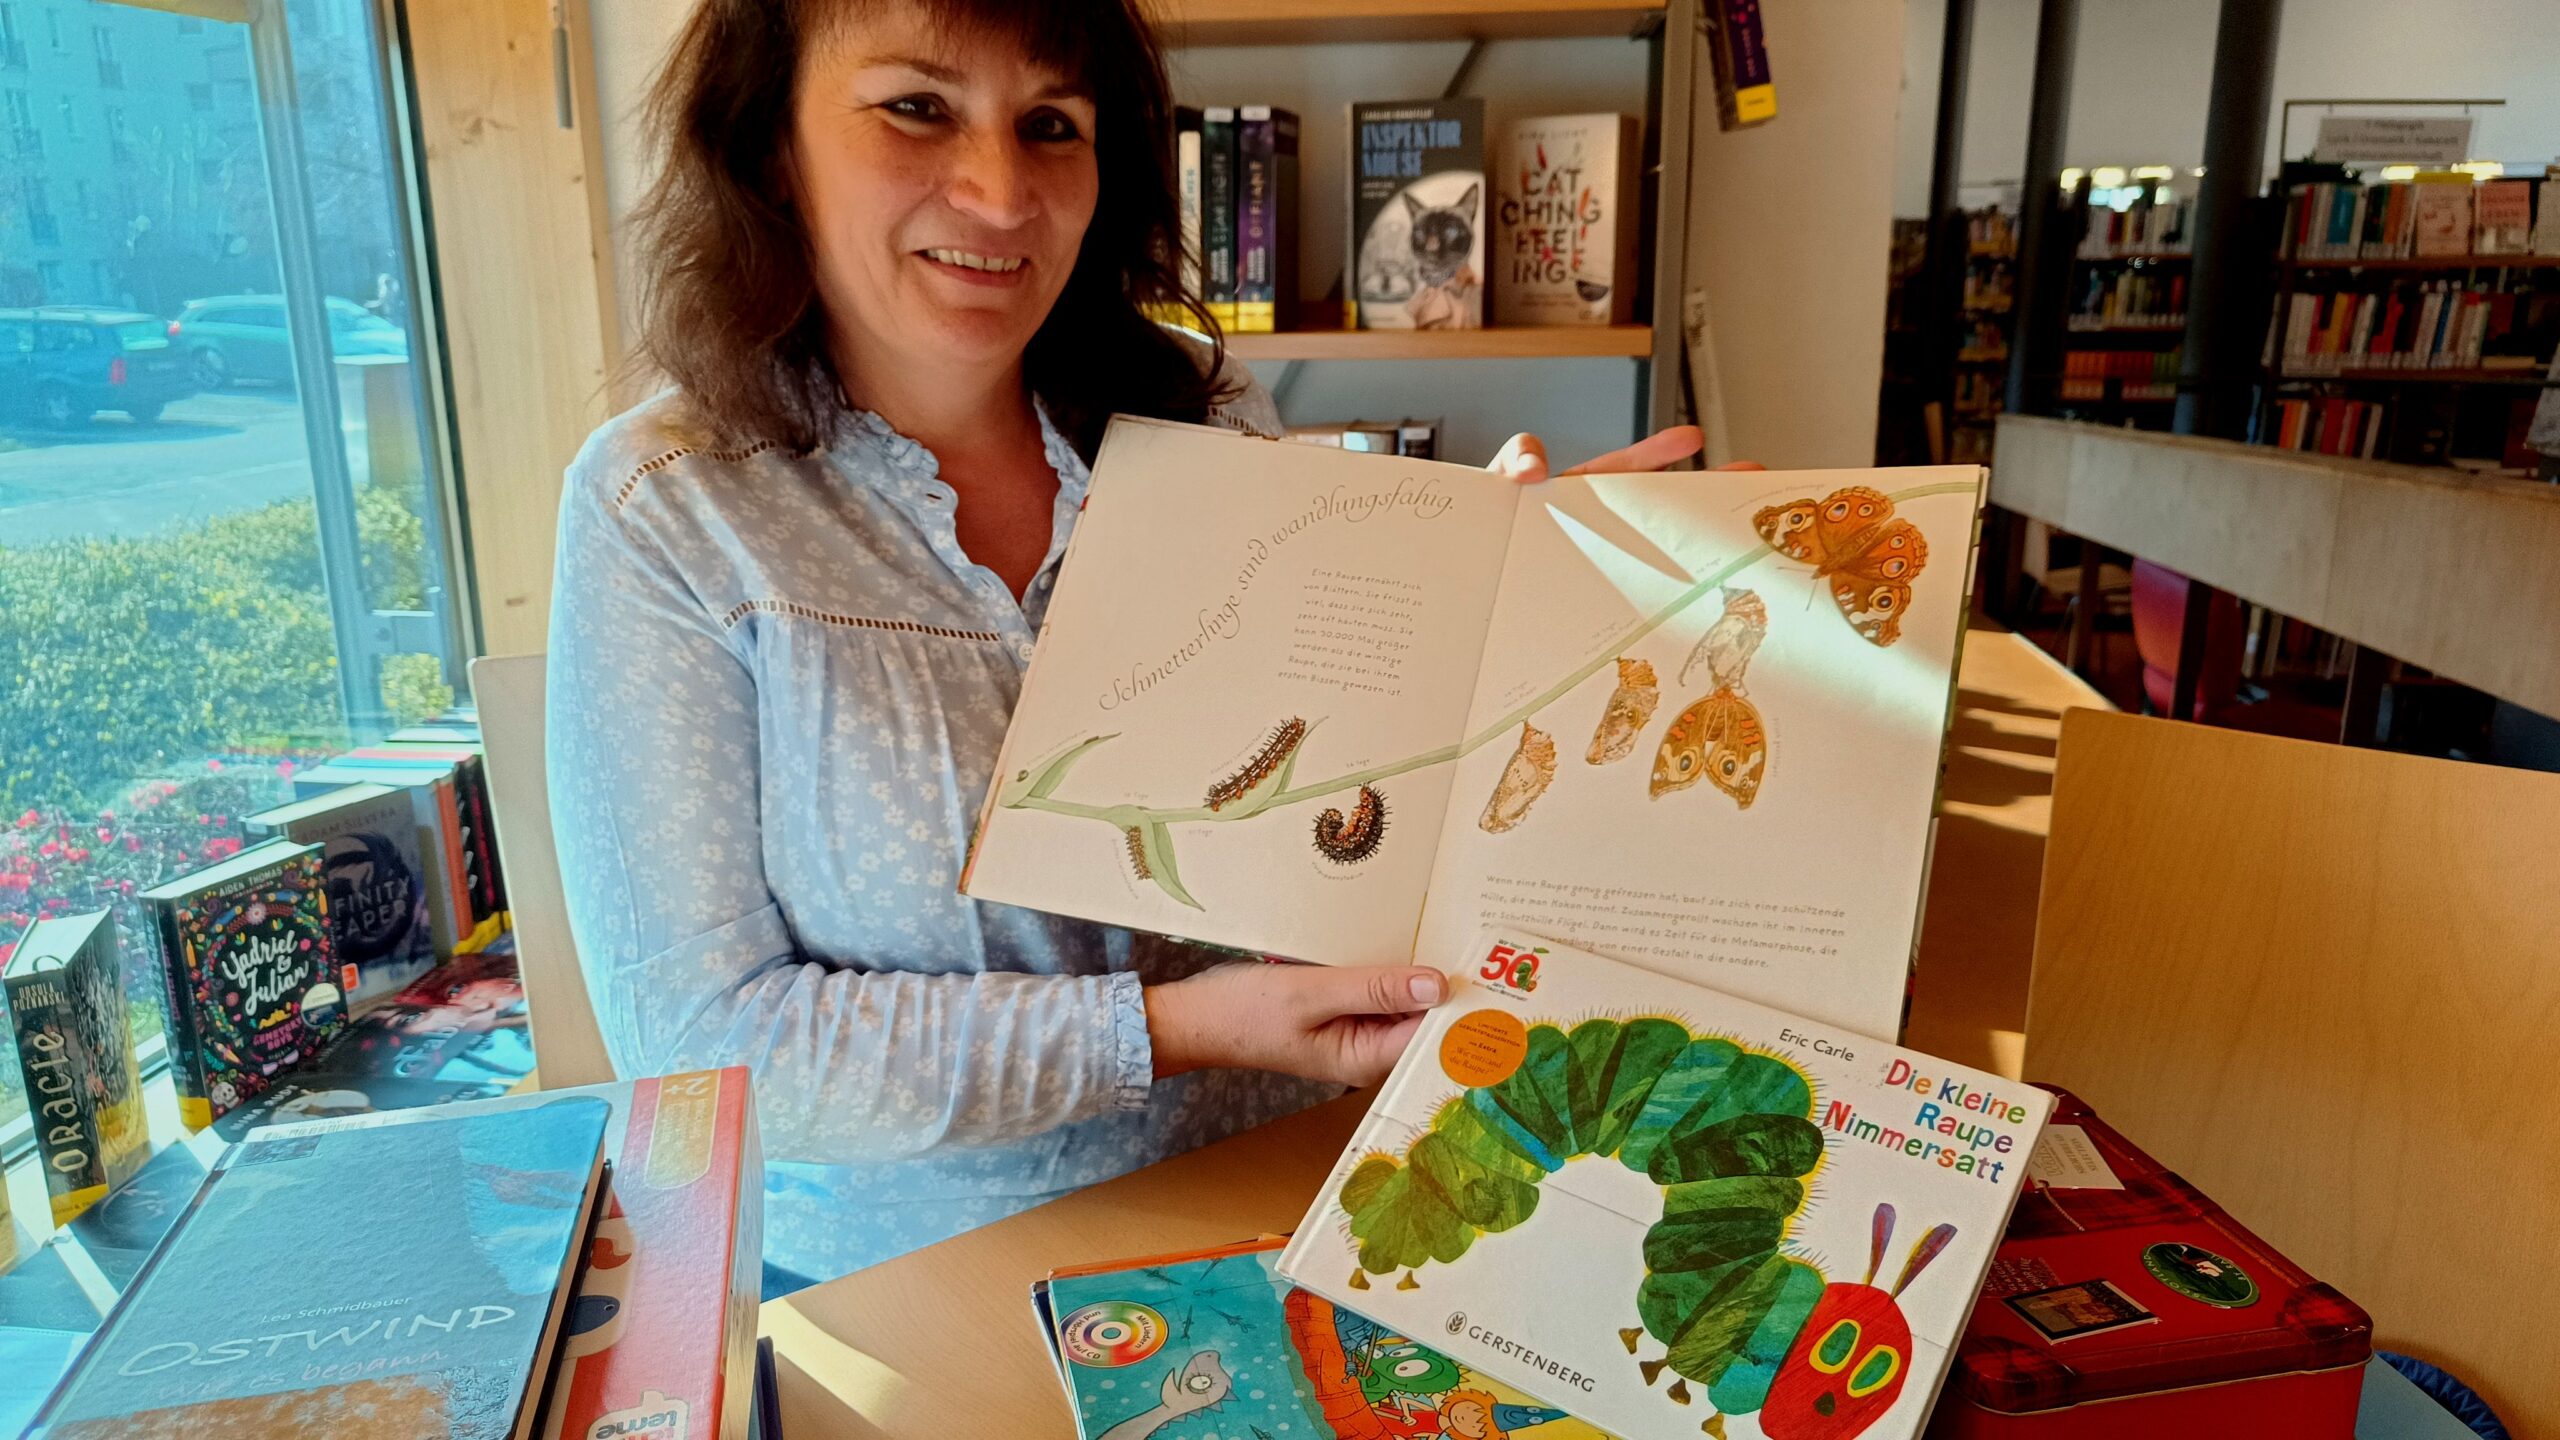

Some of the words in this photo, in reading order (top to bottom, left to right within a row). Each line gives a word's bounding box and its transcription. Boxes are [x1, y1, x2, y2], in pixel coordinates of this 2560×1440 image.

[1312, 568, 1332, 577] Eine
[1336, 571, 1362, 582] Raupe
[1328, 601, 1348, 610] dass
[1389, 612, 1413, 622] sehr,
[1366, 591, 1380, 599] Sie
[1383, 593, 1410, 604] frisst
[1099, 594, 1241, 711] Schmetterlinge
[1238, 539, 1268, 590] sind
[1294, 626, 1316, 635] kann
[1358, 635, 1374, 644] Mal
[1400, 627, 1413, 635] Sie
[1288, 656, 1317, 668] Raupe,
[1374, 671, 1400, 680] ihrem
[1294, 644, 1328, 652] werden
[1365, 654, 1402, 668] winzige
[1278, 672, 1307, 681] ersten
[1311, 675, 1340, 685] Bissen
[1342, 682, 1384, 693] gewesen
[219, 882, 245, 898] AIDEN
[247, 866, 283, 887] THOMAS
[334, 876, 410, 916] FINITY
[1487, 875, 1512, 885] Wenn
[1517, 880, 1536, 888] eine
[1540, 880, 1568, 892] Raupe
[1571, 885, 1600, 899] genug
[1603, 888, 1656, 900] gefressen
[1659, 892, 1679, 903] hat,
[1683, 895, 1705, 904] baut
[1709, 897, 1725, 906] sie
[1728, 899, 1750, 908] sich
[1755, 903, 1778, 912] eine
[1782, 904, 1845, 918] schützende
[332, 898, 408, 942] EAPER
[1511, 896, 1525, 904] die
[1551, 900, 1581, 910] Kokon
[1586, 904, 1617, 913] nennt.
[1621, 906, 1709, 926] Zusammengerollt
[1712, 917, 1758, 928] wachsen
[1763, 921, 1778, 930] ihr
[1783, 924, 1795, 932] im
[1800, 925, 1845, 937] Inneren
[1480, 909, 1495, 918] der
[1500, 912, 1553, 925] Schutzhülle
[1593, 921, 1618, 931] Dann
[1622, 926, 1645, 935] wird
[1665, 929, 1686, 939] Zeit
[1691, 931, 1707, 941] für
[1710, 936, 1727, 944] die
[1731, 937, 1816, 955] Metamorphose,
[1820, 945, 1837, 956] die
[221, 930, 298, 989] Yadriel
[277, 955, 292, 973] &
[1480, 944, 1539, 988] 50
[1599, 942, 1617, 950] von
[1622, 944, 1648, 954] einer
[1652, 946, 1689, 958] Gestalt
[1693, 949, 1703, 960] in
[1708, 952, 1724, 962] die
[12, 991, 65, 1012] POZNANSKI
[19, 982, 55, 999] URSULA
[245, 961, 309, 1016] Julian
[1779, 1028, 1809, 1048] Eric
[1813, 1039, 1855, 1062] Carle
[663, 1076, 711, 1096] 2+
[1885, 1059, 1932, 1096] Die
[1938, 1077, 2026, 1125] kleine
[1823, 1100, 2004, 1184] Nimmersatt
[1915, 1102, 2013, 1154] Raupe
[2144, 1255, 2200, 1298] SCOTLAND
[260, 1312, 296, 1324] Lea
[298, 1296, 413, 1319] Schmidbauer
[1083, 1311, 1101, 1320] und
[1136, 1315, 1149, 1327] Mit
[118, 1304, 517, 1377] OSTWIND
[1068, 1321, 1083, 1344] Hörspiel
[1135, 1325, 1152, 1349] Liedern
[1073, 1344, 1087, 1353] auf
[1468, 1325, 1596, 1393] GERSTENBERG
[301, 1350, 450, 1382] begann
[595, 1409, 678, 1439] lerne
